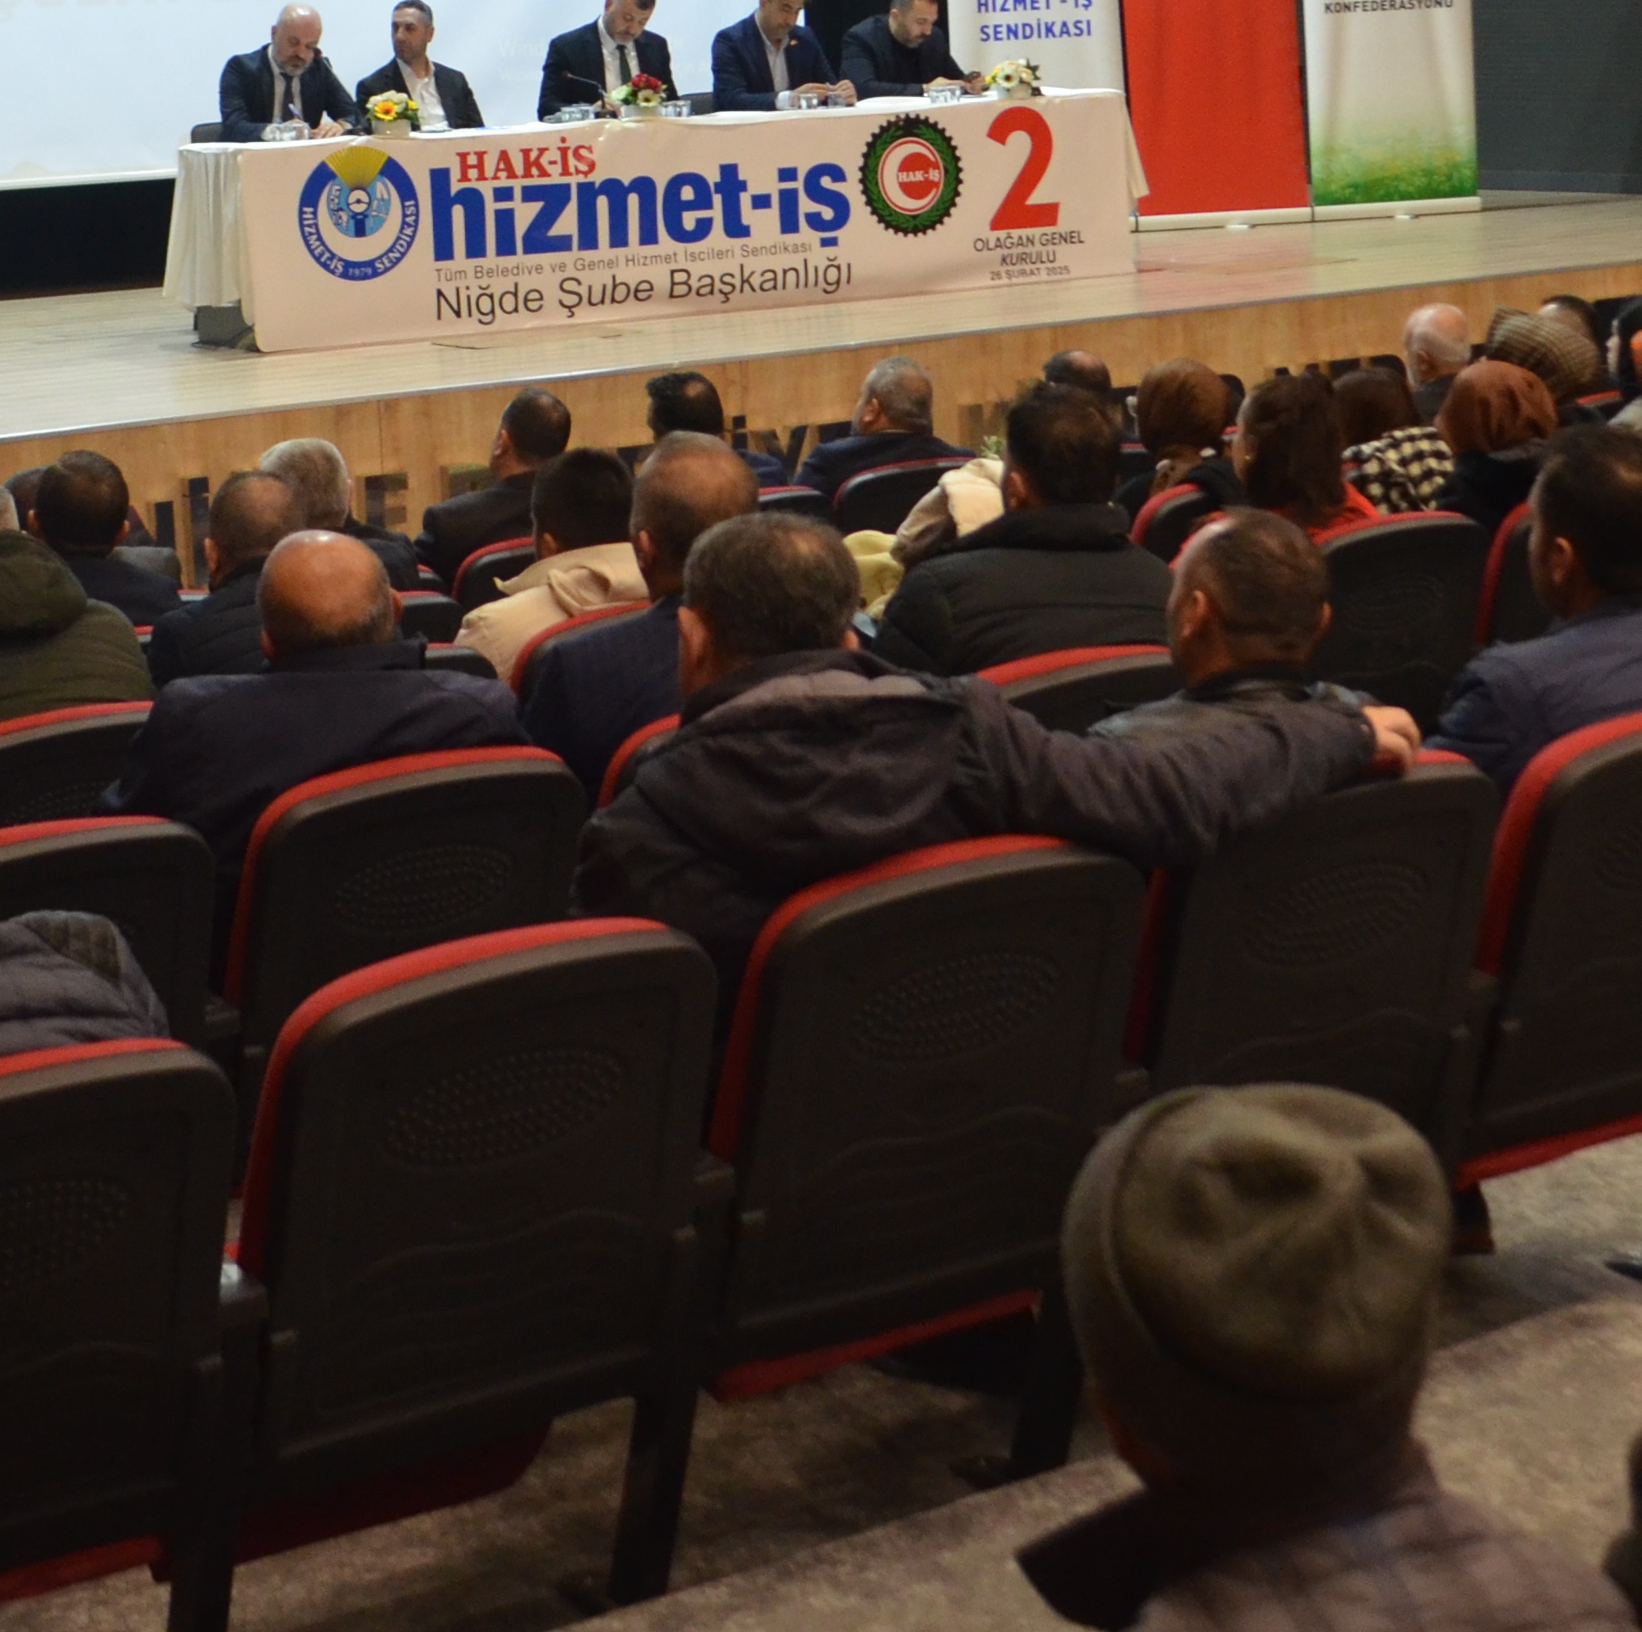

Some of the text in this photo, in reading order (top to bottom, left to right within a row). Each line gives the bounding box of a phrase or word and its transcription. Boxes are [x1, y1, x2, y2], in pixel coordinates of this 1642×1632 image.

[979, 19, 1093, 43] SENDİKASI
[455, 136, 597, 183] HAK-İŞ
[897, 167, 941, 183] HAK-İŞ
[986, 105, 1061, 232] 2
[429, 162, 852, 263] hizmet-iş
[302, 206, 345, 277] HİZMET-İŞ
[374, 199, 417, 273] SENDİKASI
[973, 229, 1085, 253] OLAĞAN GENEL
[1000, 249, 1057, 267] KURULU
[435, 268, 468, 283] Tüm
[550, 260, 567, 274] ve
[573, 256, 620, 273] Genel
[625, 249, 679, 268] Hizmet
[740, 240, 813, 259] Sendikası
[435, 255, 852, 326] Niğde Şube Başkanlığı
